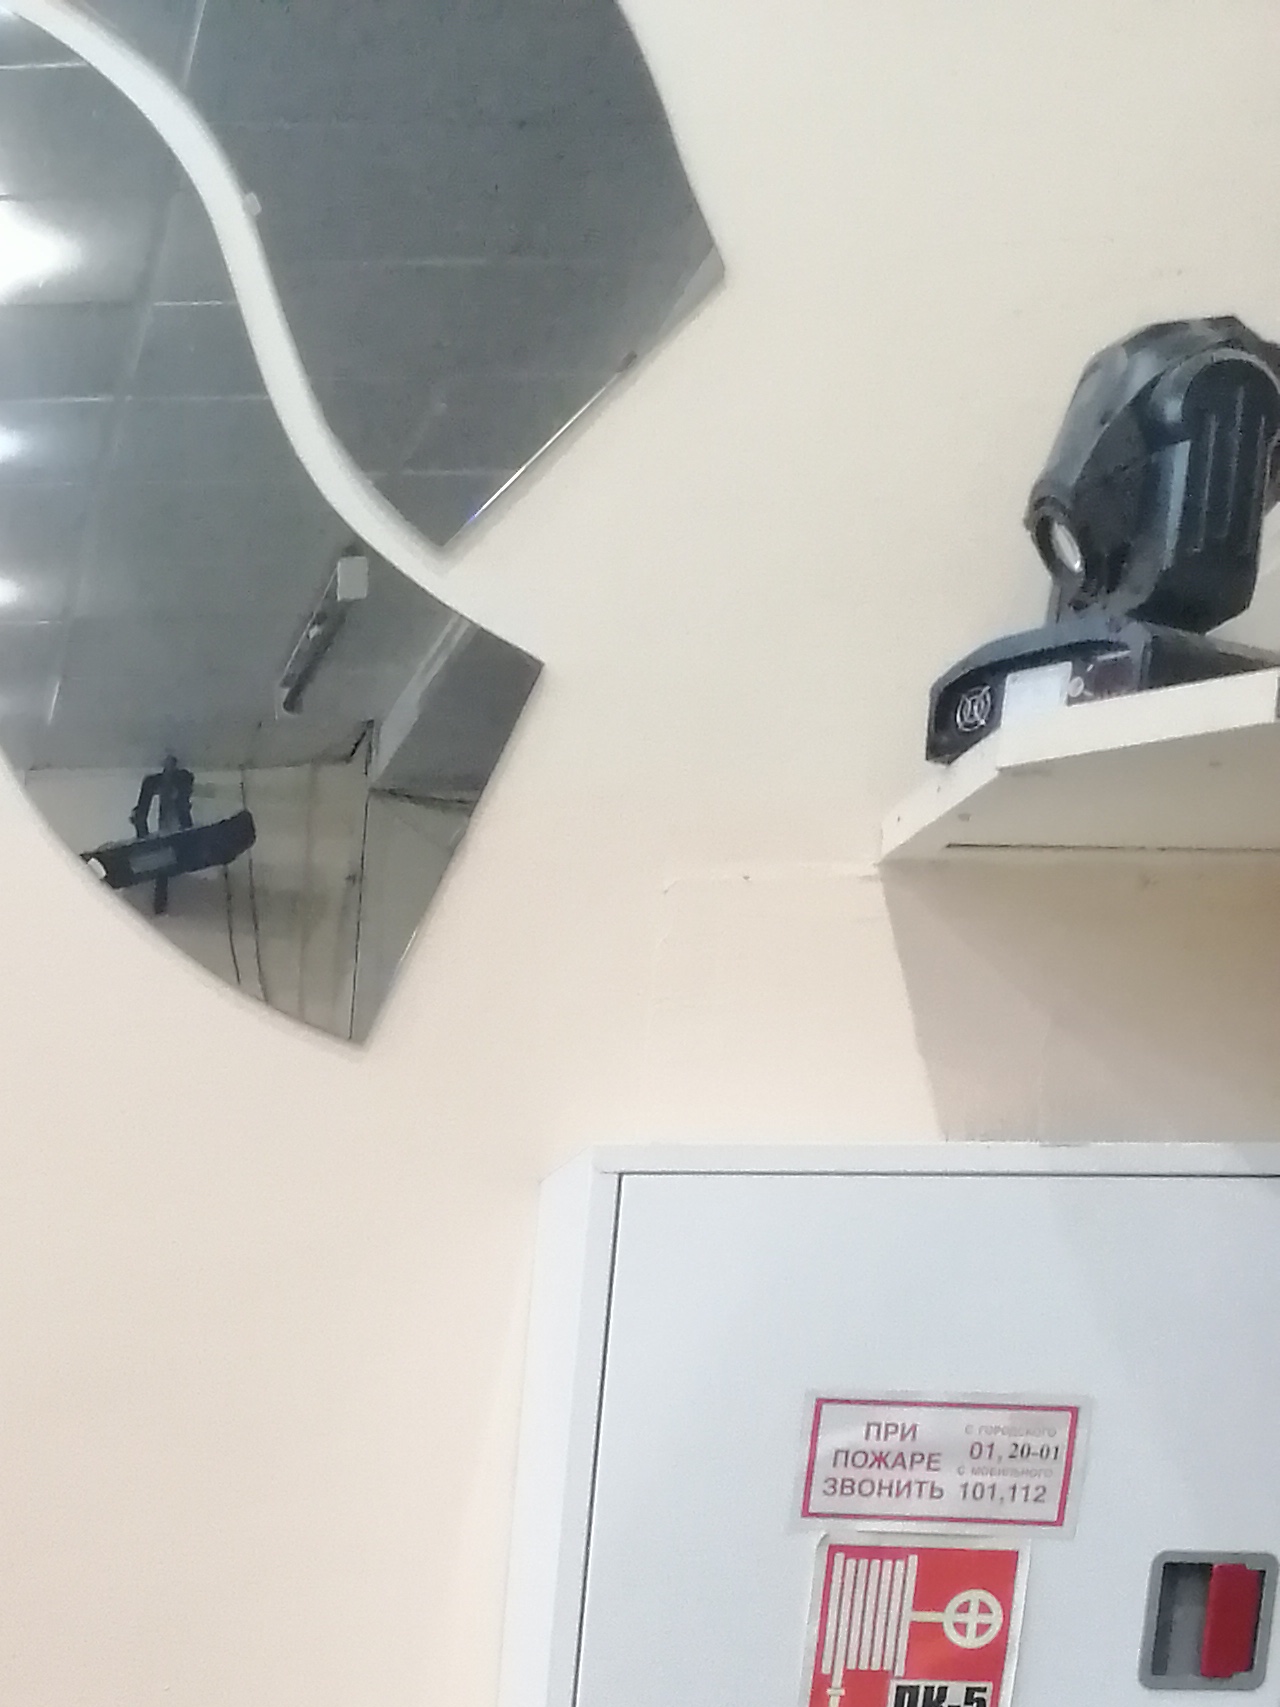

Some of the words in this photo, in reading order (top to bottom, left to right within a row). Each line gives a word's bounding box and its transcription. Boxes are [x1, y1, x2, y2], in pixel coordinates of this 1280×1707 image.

[864, 1420, 919, 1442] ПРИ
[832, 1448, 943, 1472] ПОЖАРЕ
[1007, 1441, 1060, 1461] 20-01
[821, 1476, 945, 1501] ЗВОНИТЬ
